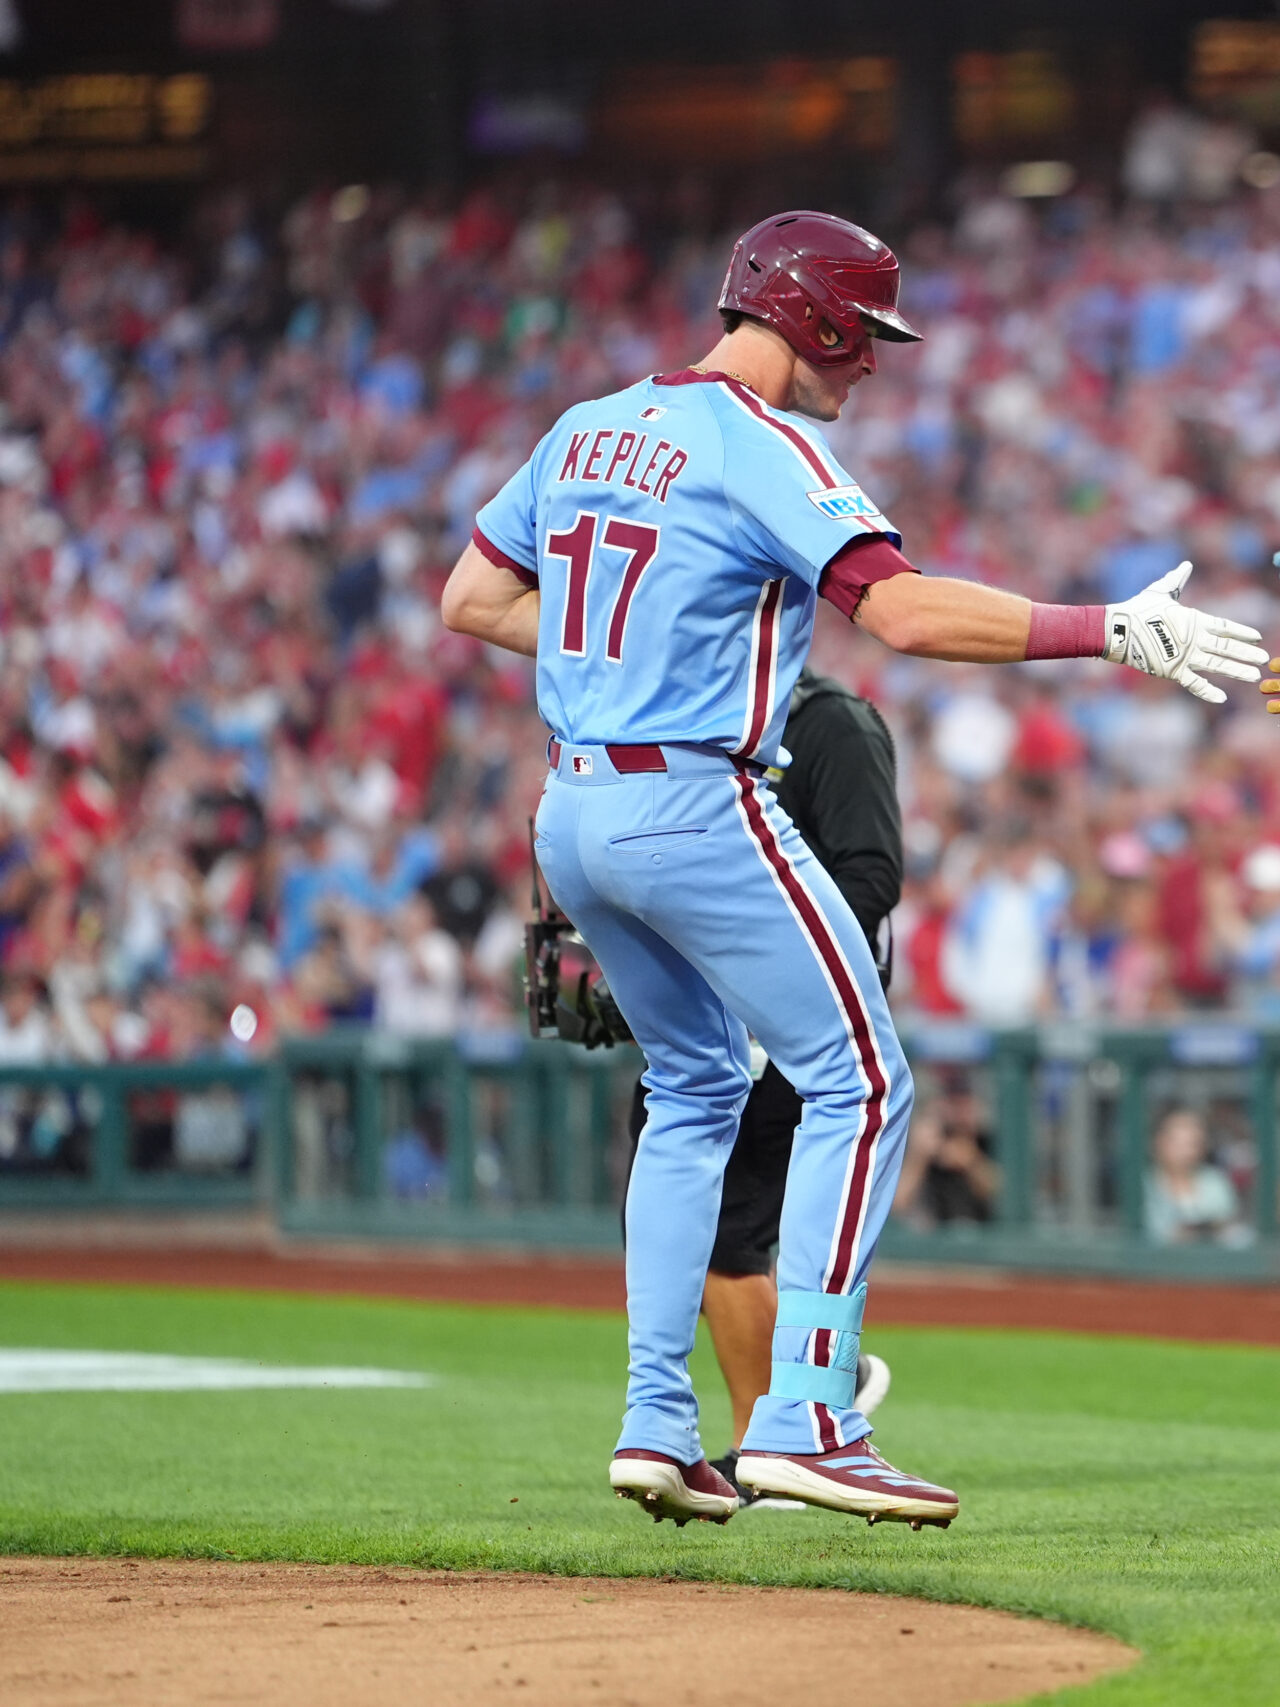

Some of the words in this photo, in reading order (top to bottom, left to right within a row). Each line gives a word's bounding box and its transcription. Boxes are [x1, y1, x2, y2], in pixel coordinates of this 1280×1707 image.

[557, 428, 689, 506] KEPLER
[818, 495, 875, 517] IBX
[543, 509, 662, 665] 17
